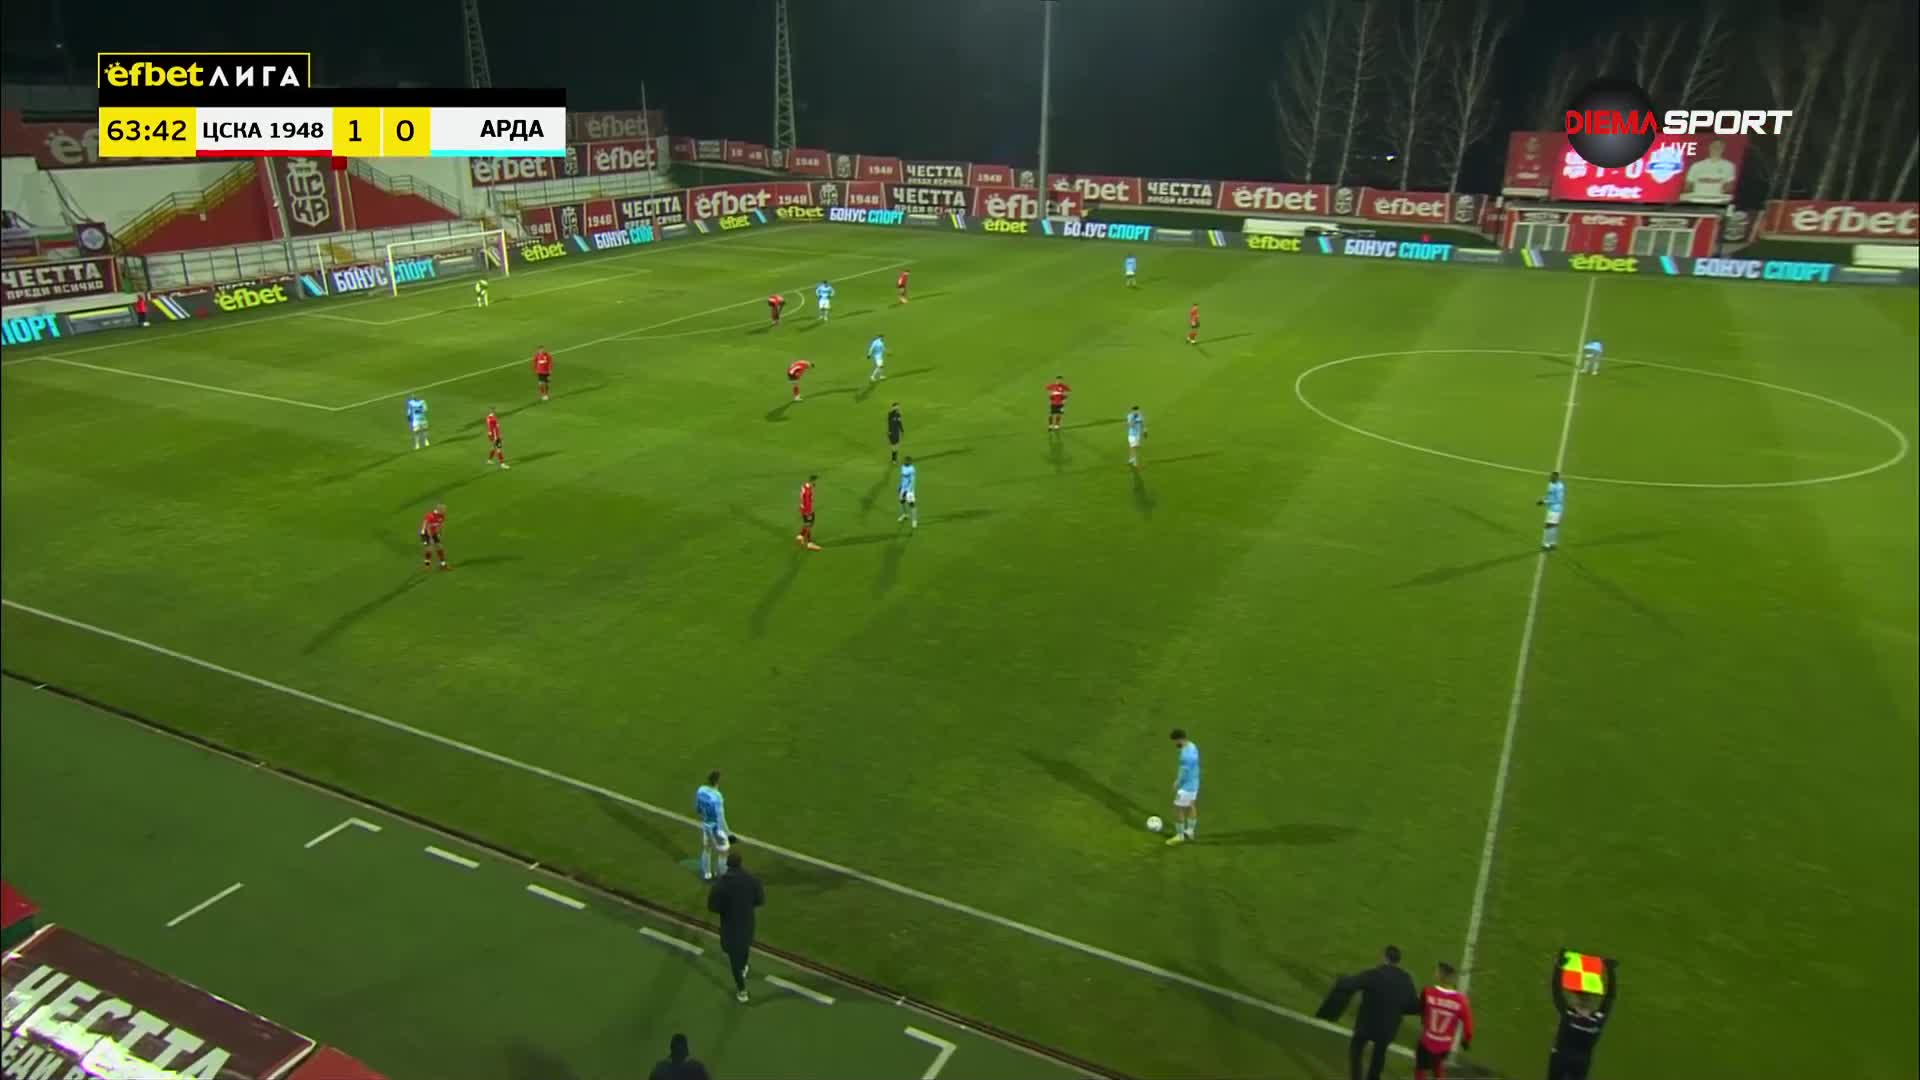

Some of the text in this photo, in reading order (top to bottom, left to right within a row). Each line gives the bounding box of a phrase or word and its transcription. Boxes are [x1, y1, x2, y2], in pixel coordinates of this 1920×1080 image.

[594, 147, 655, 171] efbet
[906, 164, 963, 177] ЧЕСТТА
[893, 187, 966, 207] ЧЕСТТА
[1147, 182, 1213, 197] ЧЕСТТА
[1233, 186, 1317, 211] efbet
[622, 196, 681, 219] ЧЕСТТА
[695, 189, 771, 219] efbet
[777, 206, 824, 218] efbet
[984, 192, 1076, 220] efbt
[1374, 197, 1444, 217] efbet
[829, 208, 904, 224] БОНУС СПОРТ
[982, 218, 1027, 233] efbet
[1791, 205, 1919, 234] efbet
[530, 222, 552, 235] 948
[1108, 224, 1152, 240] СПОРТ
[594, 230, 630, 249] БОНУС
[1247, 235, 1301, 251] efbet
[1344, 239, 1450, 260] БОНУС СПОРТ
[521, 242, 567, 261] efbet
[1569, 254, 1639, 273] efbet
[2, 263, 102, 289] ЧЕСТТА
[334, 265, 388, 293] БОНУС
[214, 283, 288, 312] efbet
[2, 312, 60, 346] ПОРТ
[1431, 1008, 1455, 1033] 17
